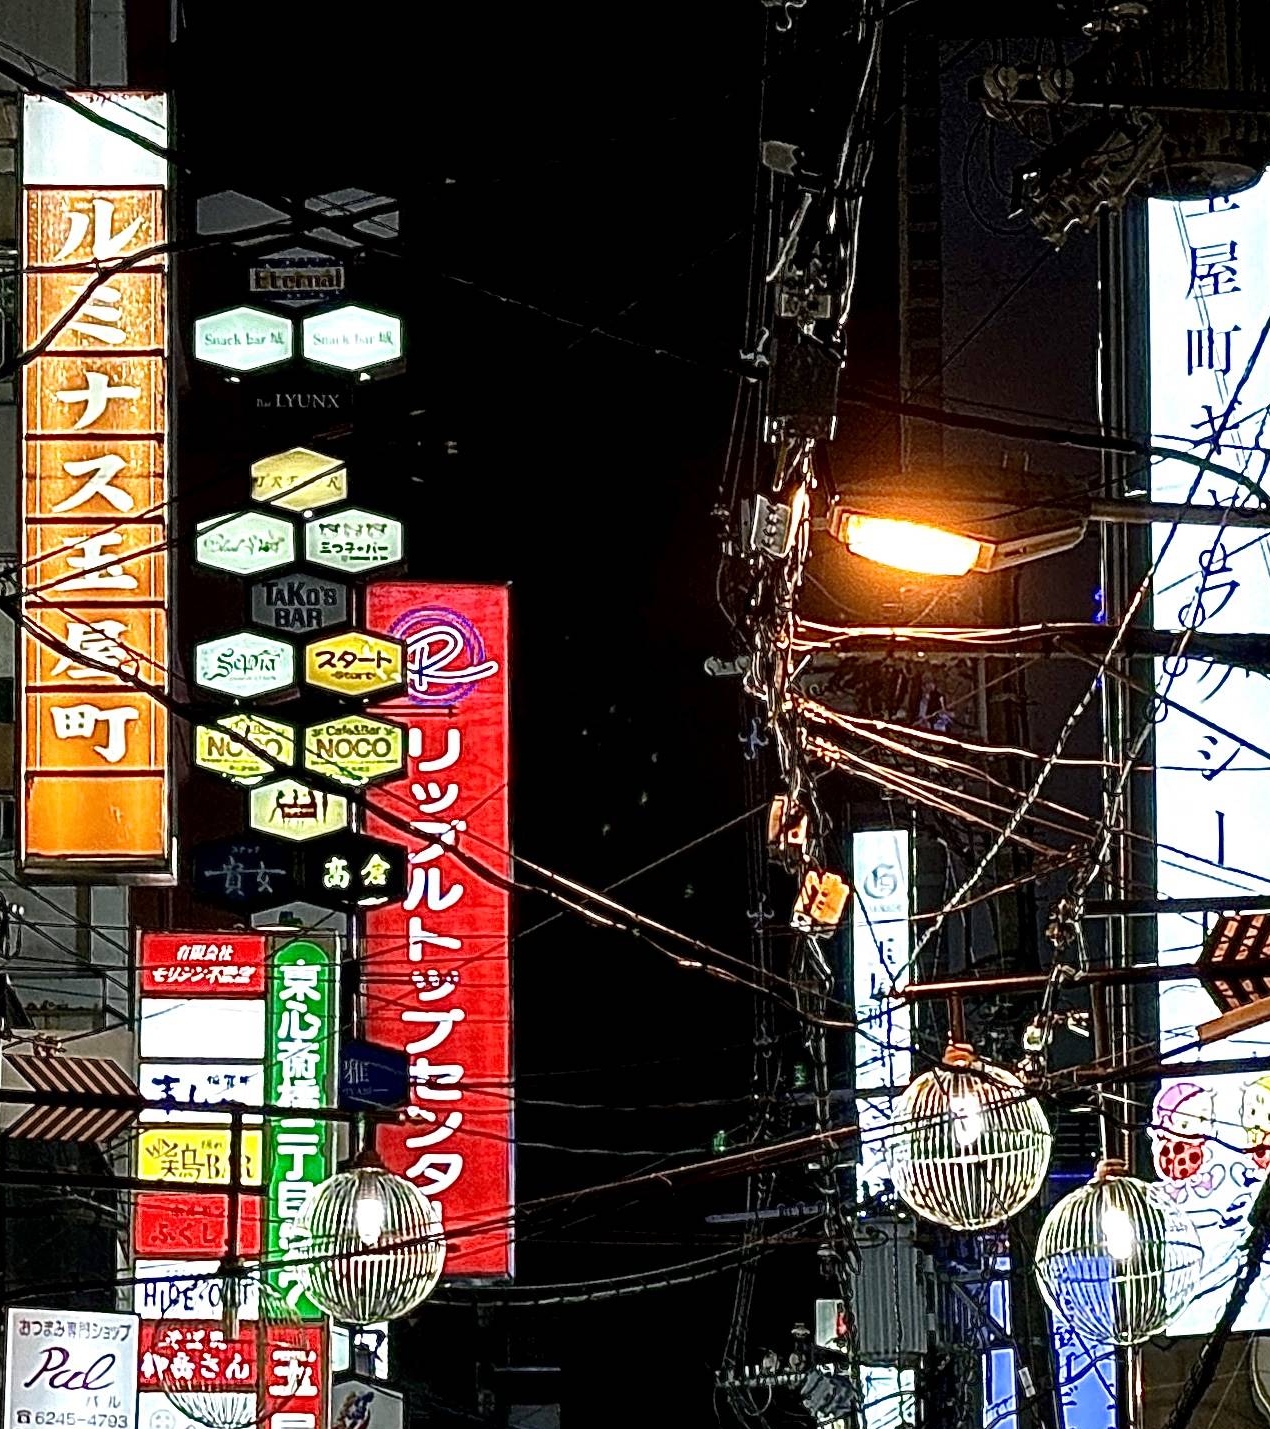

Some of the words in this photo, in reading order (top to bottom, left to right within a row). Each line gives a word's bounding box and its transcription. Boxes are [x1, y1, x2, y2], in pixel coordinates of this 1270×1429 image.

[204, 332, 241, 346] Snack
[275, 393, 340, 408] LYUNX
[50, 197, 146, 764] ルミナス玉屋町
[274, 608, 323, 628] BAR
[315, 650, 393, 670] スタート
[316, 737, 392, 759] NOCO
[207, 1153, 254, 1180] BR
[19, 1319, 132, 1342] おつまみ専門ショップ
[35, 1410, 128, 1429] 6245-4793
